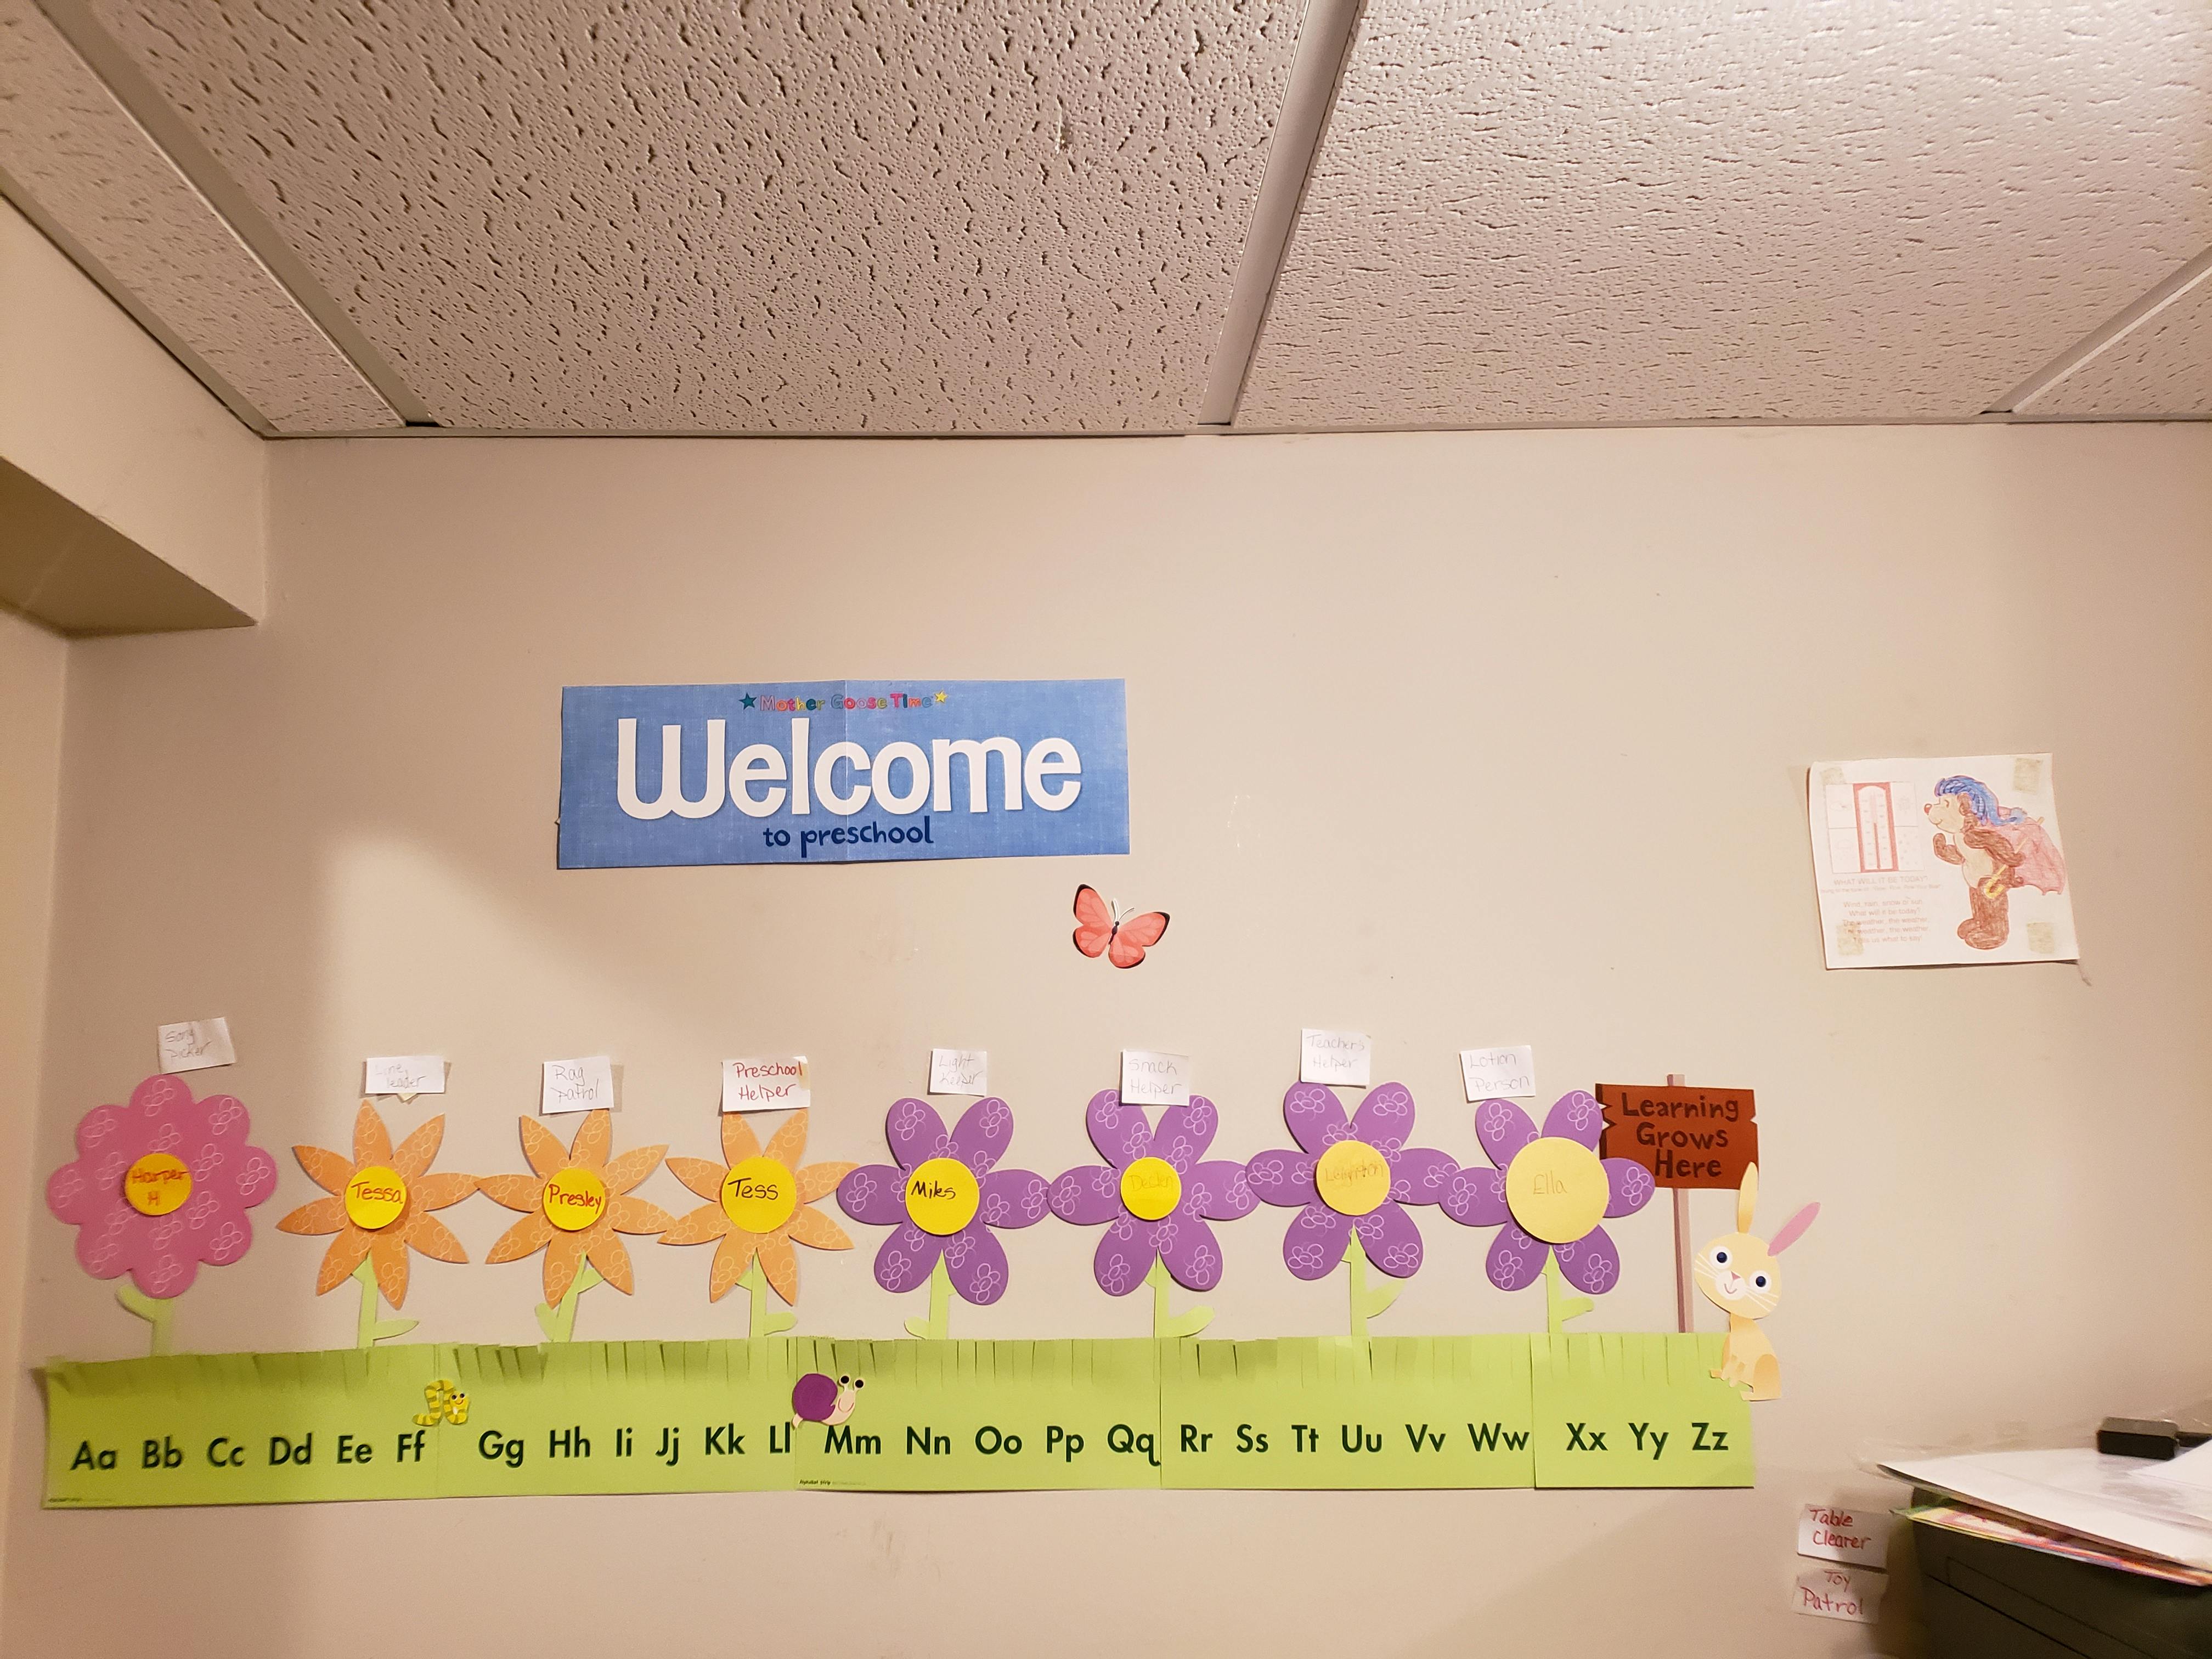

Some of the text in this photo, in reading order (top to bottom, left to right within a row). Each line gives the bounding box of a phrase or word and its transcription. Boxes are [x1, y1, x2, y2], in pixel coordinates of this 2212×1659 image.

[760, 695, 825, 712] Mother
[831, 693, 888, 710] Goose
[617, 717, 1081, 820] Welcome
[763, 815, 934, 858] to preschool
[1306, 1034, 1365, 1051] Teacher's
[732, 1060, 803, 1078] Preschool
[939, 1053, 975, 1073] Light
[1313, 1054, 1358, 1072] Helper
[1470, 1052, 1517, 1069] Lotion
[552, 1064, 585, 1086] Rag
[1468, 1075, 1530, 1092] Person
[738, 1083, 797, 1102] Helper
[1131, 1077, 1182, 1099] Helper
[1621, 1092, 1739, 1122] Learning
[1636, 1122, 1729, 1150] Grows
[1654, 1148, 1722, 1179] Here
[351, 1181, 403, 1204] Tessa
[727, 1177, 778, 1200] Tess
[1533, 1170, 1567, 1195] Ella
[549, 1183, 602, 1215] Presley
[70, 1421, 1728, 1470] Aa Bb Cc Dd Ee Ff Gg Hh Ii Jj Kk Ll Mm Nn Oo Pp Qq Rr Ss Tt Uu Vv Ww Xx Yy Zz
[1809, 1508, 1853, 1527] Table
[1813, 1530, 1872, 1549] Clearer
[1823, 1570, 1851, 1593] Toy
[1800, 1586, 1864, 1615] Patrol
